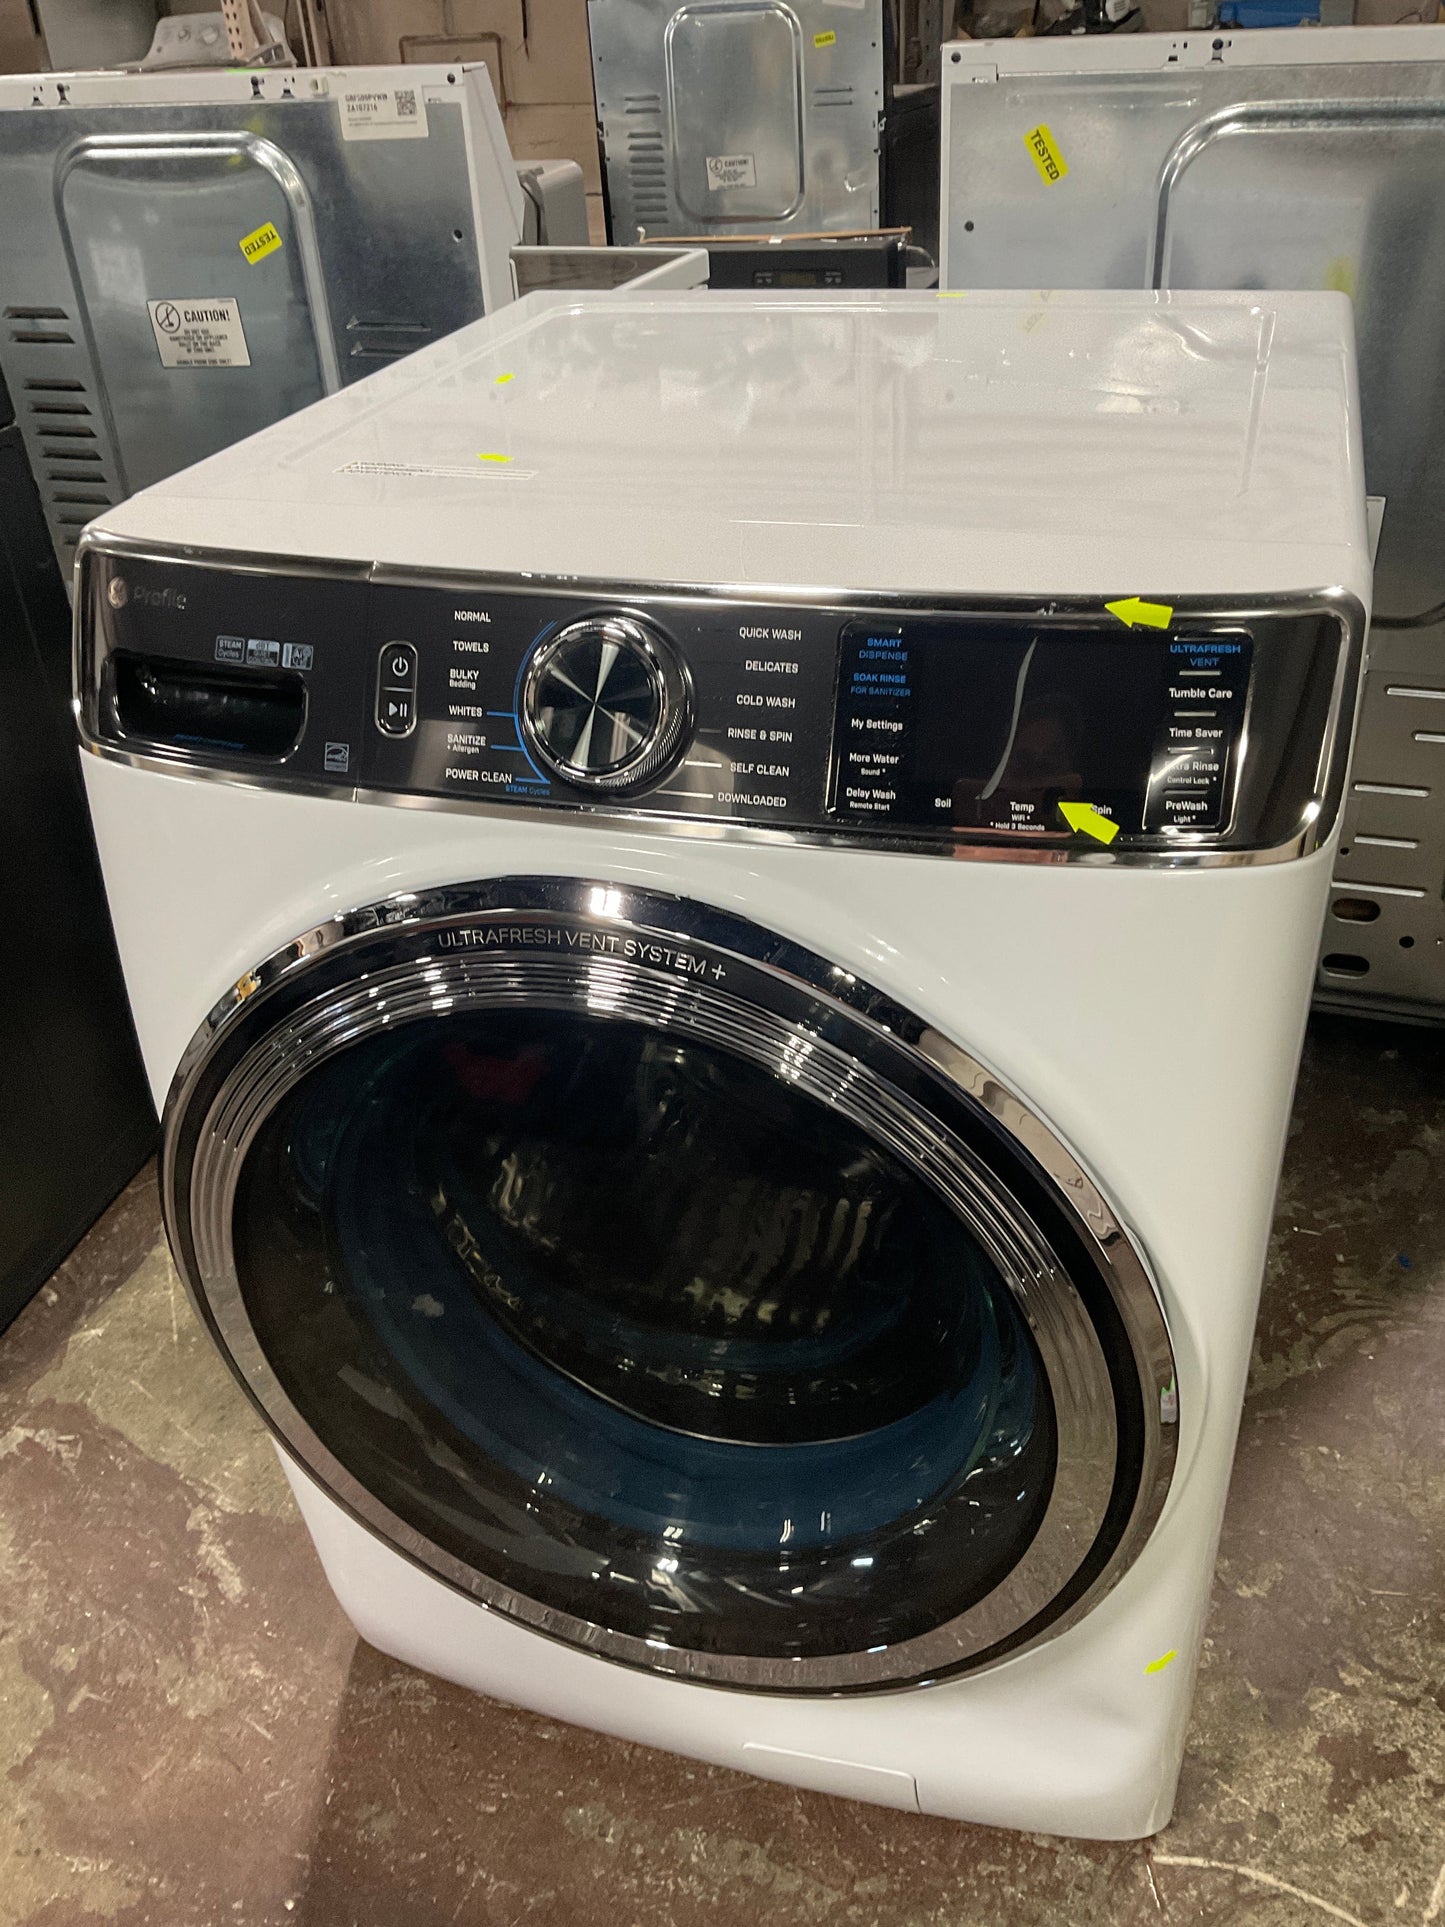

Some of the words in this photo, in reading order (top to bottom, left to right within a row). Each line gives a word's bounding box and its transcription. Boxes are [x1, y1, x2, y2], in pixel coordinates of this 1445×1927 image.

[1030, 128, 1060, 181] TESTED
[244, 230, 276, 256] TESTED
[183, 309, 230, 323] CAUTION!
[454, 610, 492, 623] NORMAL
[739, 626, 770, 640] QUICK
[771, 628, 802, 641] WASH
[452, 640, 490, 653] TOWELS
[867, 637, 902, 648] SMART
[1169, 643, 1242, 654] ULTRAFRESH
[859, 649, 908, 662] DISPENSE
[1189, 657, 1220, 667] VENT
[745, 659, 799, 674] DELICATES
[449, 668, 480, 681] BULKY
[853, 672, 879, 682] SOAK
[879, 673, 907, 684] RINSE
[449, 679, 476, 691] Bedding
[850, 685, 868, 695] FOR
[868, 686, 911, 697] SANITIZER
[1168, 687, 1207, 699] Tumble
[1208, 687, 1233, 699] Care
[736, 693, 763, 706] COLD
[765, 695, 796, 709] WASH
[448, 704, 483, 718] WHITES
[851, 718, 864, 730] My
[866, 718, 903, 733] Settings
[727, 727, 757, 740] RINSE
[759, 729, 767, 741] &
[769, 730, 793, 743] SPIN
[1168, 727, 1193, 738] Time
[1195, 727, 1223, 739] Saver
[447, 733, 487, 747] SANITIZE
[452, 744, 480, 755] Allergen
[849, 752, 871, 763] More
[872, 753, 899, 765] Water
[730, 761, 755, 774] SELF
[756, 763, 790, 777] CLEAN
[860, 767, 881, 776] Sound
[1164, 760, 1190, 771] tra
[1192, 761, 1220, 772] Rinse
[445, 767, 479, 782] POWER
[481, 770, 513, 784] CLEAN
[1166, 776, 1192, 784] Control
[1193, 776, 1210, 785] Lock
[505, 784, 529, 794] STEAM
[846, 787, 871, 800] Delay
[872, 789, 897, 800] Wash
[717, 791, 787, 808] DOWNLOADED
[849, 800, 873, 810] Remote
[873, 802, 890, 812] Start
[934, 797, 952, 809] Soil
[1010, 801, 1035, 814] Temp
[1091, 804, 1113, 816] Spin
[1165, 801, 1208, 812] PreWash
[1173, 815, 1191, 824] Light
[995, 821, 1010, 830] Hold
[1017, 822, 1046, 832] Seconds
[437, 926, 561, 949] ULTRAFRESH
[564, 929, 620, 954] VENT
[622, 938, 708, 976] SYSTEM
